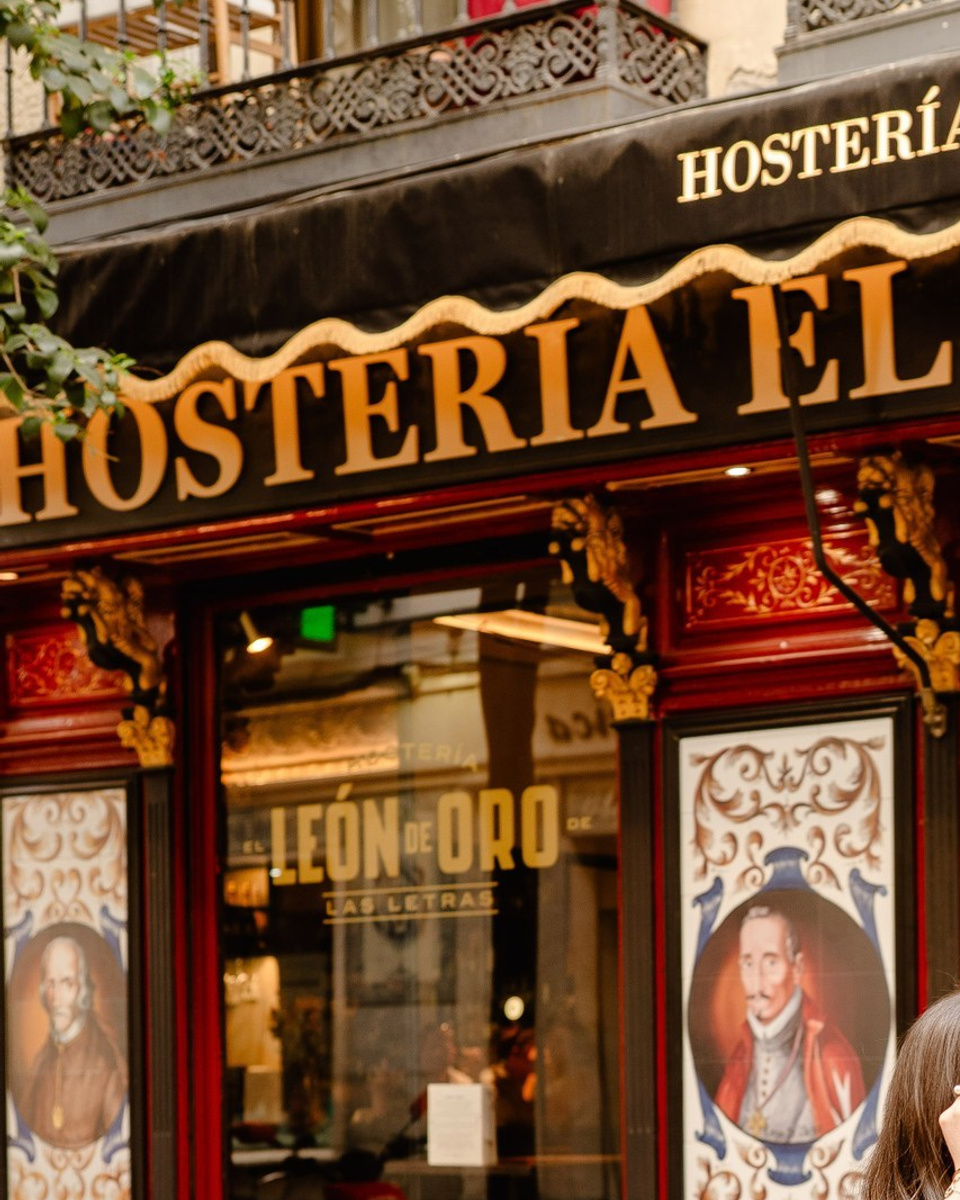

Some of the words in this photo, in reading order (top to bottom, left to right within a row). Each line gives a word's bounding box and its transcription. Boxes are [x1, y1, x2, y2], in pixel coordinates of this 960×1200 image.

[732, 260, 953, 416] EL
[242, 839, 265, 854] EL
[270, 783, 400, 887] LEÓN
[404, 820, 433, 855] DE
[437, 784, 560, 875] ORO
[566, 816, 593, 832] DE
[326, 896, 376, 917] LAS
[388, 889, 496, 913] LETRAS
